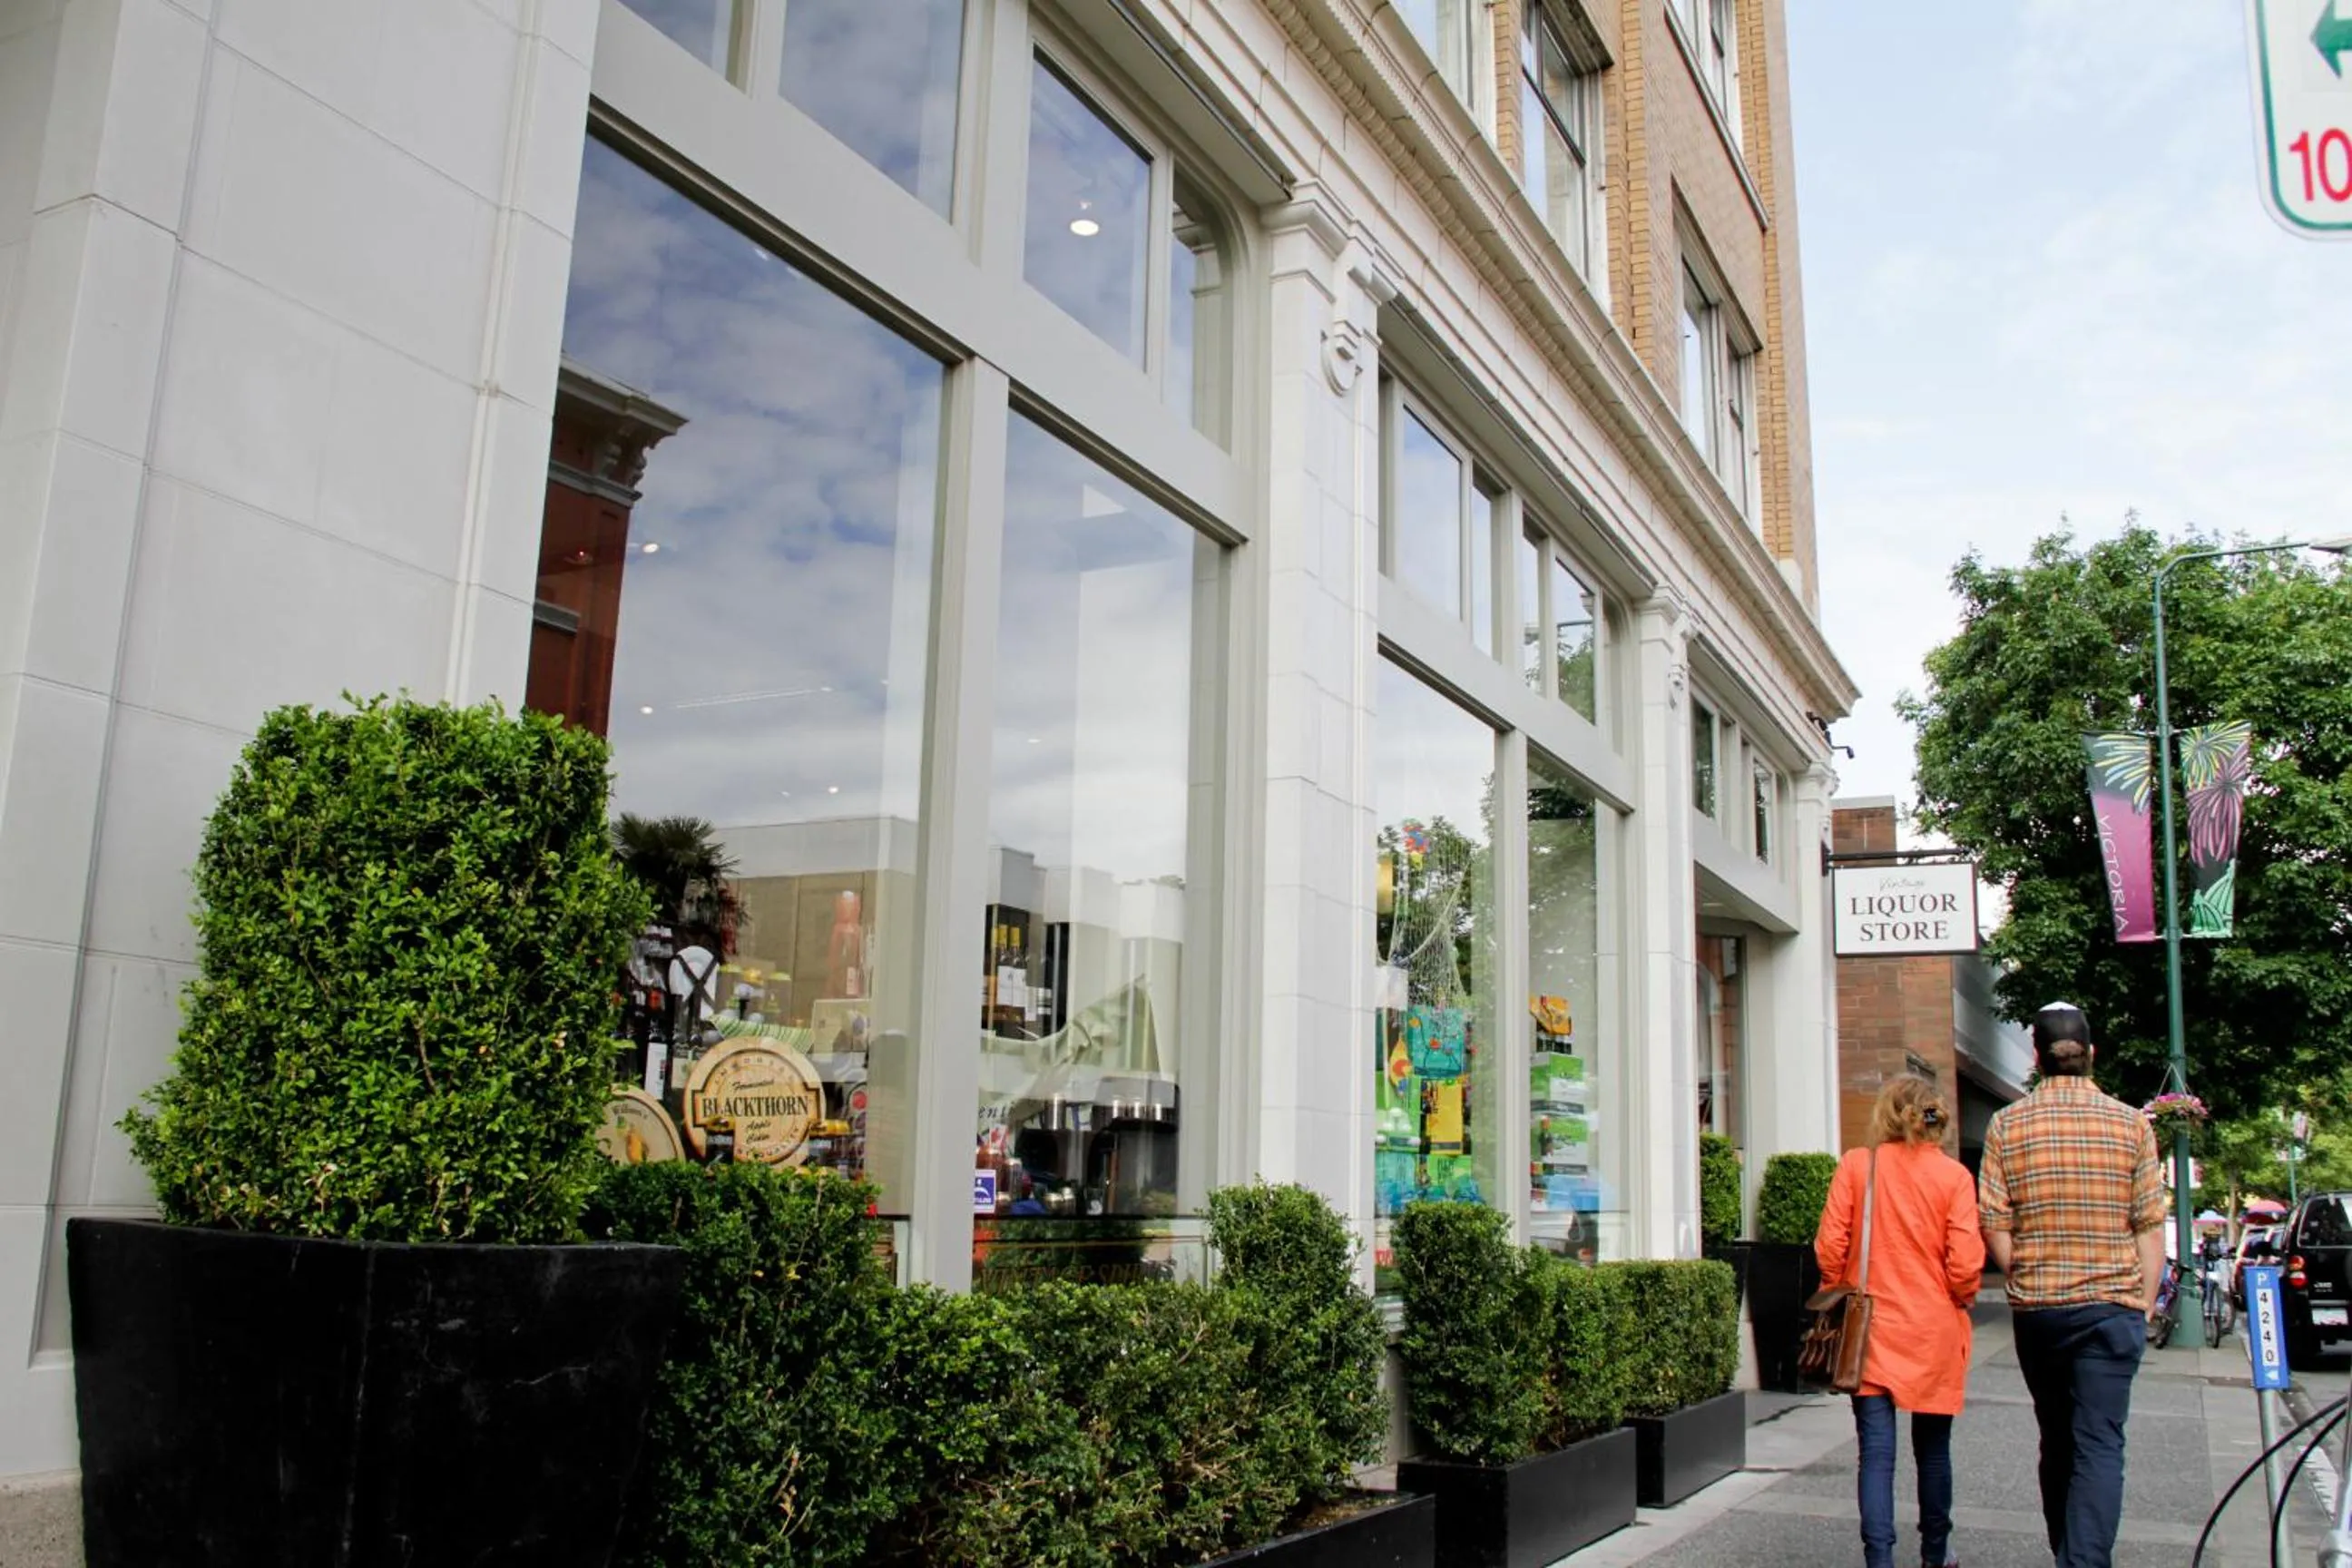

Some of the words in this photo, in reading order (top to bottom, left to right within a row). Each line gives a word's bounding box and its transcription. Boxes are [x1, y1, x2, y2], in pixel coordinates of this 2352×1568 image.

[2288, 128, 2352, 202] 10
[2098, 815, 2130, 932] VICTORIA
[1851, 894, 1958, 917] LIQUOR
[1860, 920, 1949, 942] STORE
[702, 1095, 808, 1118] BLACKTHORN
